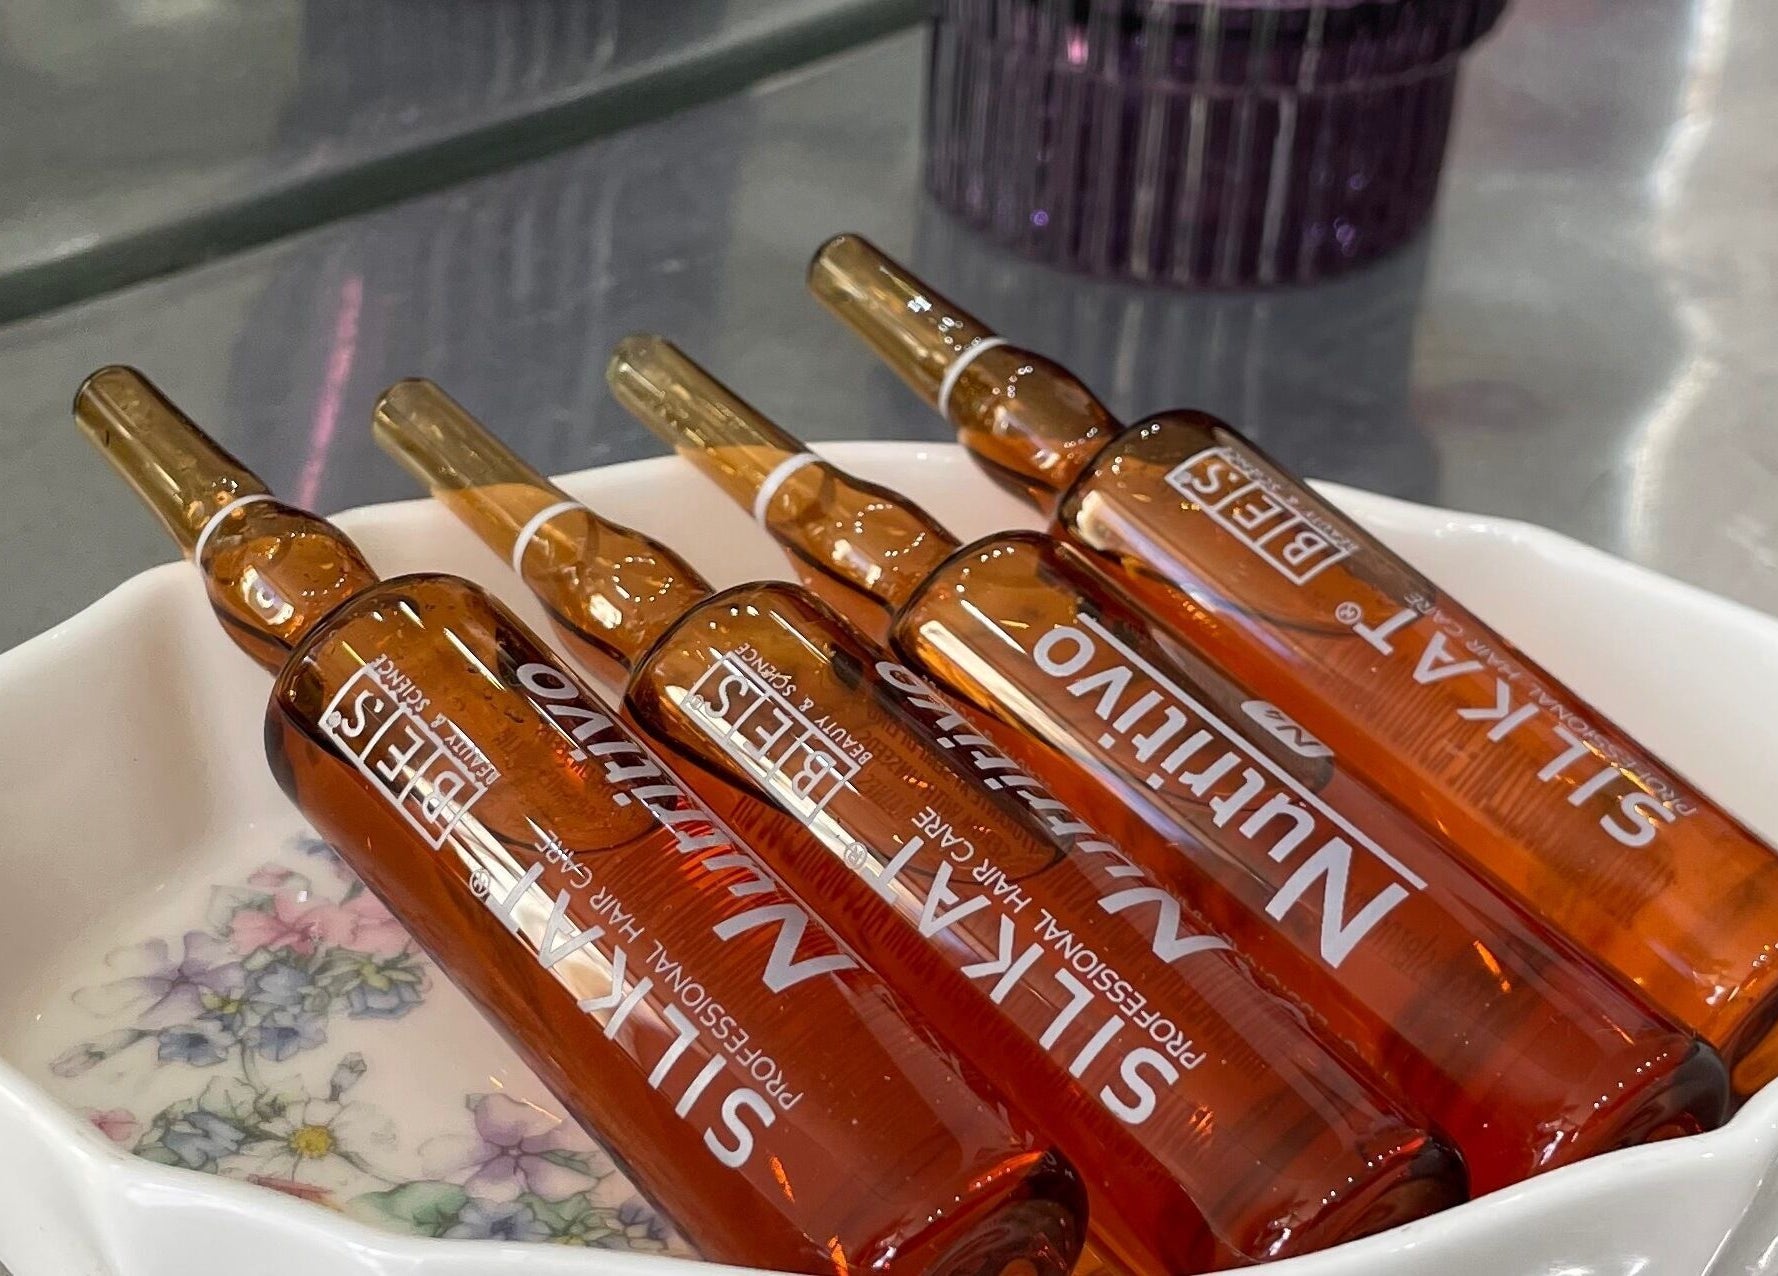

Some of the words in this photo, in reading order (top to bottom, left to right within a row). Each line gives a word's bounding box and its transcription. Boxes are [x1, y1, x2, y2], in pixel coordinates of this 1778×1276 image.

[1404, 593, 1463, 637] CARE
[368, 653, 431, 713] SCIENCE
[735, 642, 797, 697] SCIENCE
[431, 713, 449, 729] &
[798, 697, 815, 712] &
[445, 728, 502, 785] BEAUTY
[812, 714, 873, 769] BEAUTY
[876, 661, 1232, 963] Nutritivo
[1033, 625, 1410, 968] Nutritivo
[516, 663, 855, 993] Nutritivo
[912, 806, 974, 863] CARE
[535, 829, 593, 888] CARE
[972, 859, 1032, 914] HAIR
[589, 886, 645, 943] HAIR
[1034, 908, 1207, 1069] PROFESSIONAL
[645, 939, 804, 1110] PROFESSIONAL
